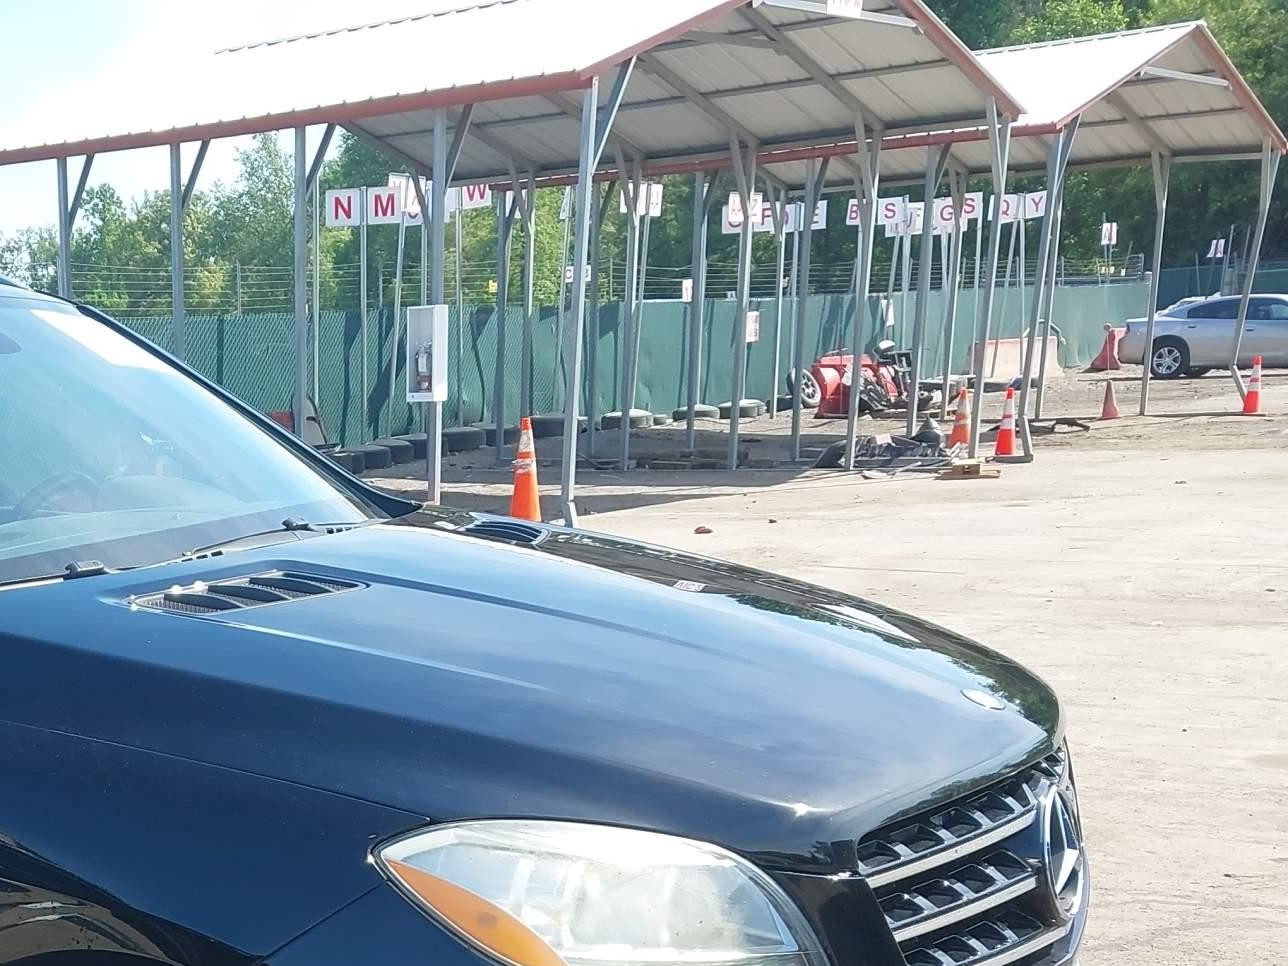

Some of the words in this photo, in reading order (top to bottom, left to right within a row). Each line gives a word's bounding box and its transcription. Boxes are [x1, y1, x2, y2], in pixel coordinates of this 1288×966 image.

[334, 196, 352, 220] N
[374, 193, 395, 217] M
[884, 202, 896, 219] S
[963, 197, 975, 214] S
[1031, 196, 1043, 213] Y
[940, 205, 953, 222] G
